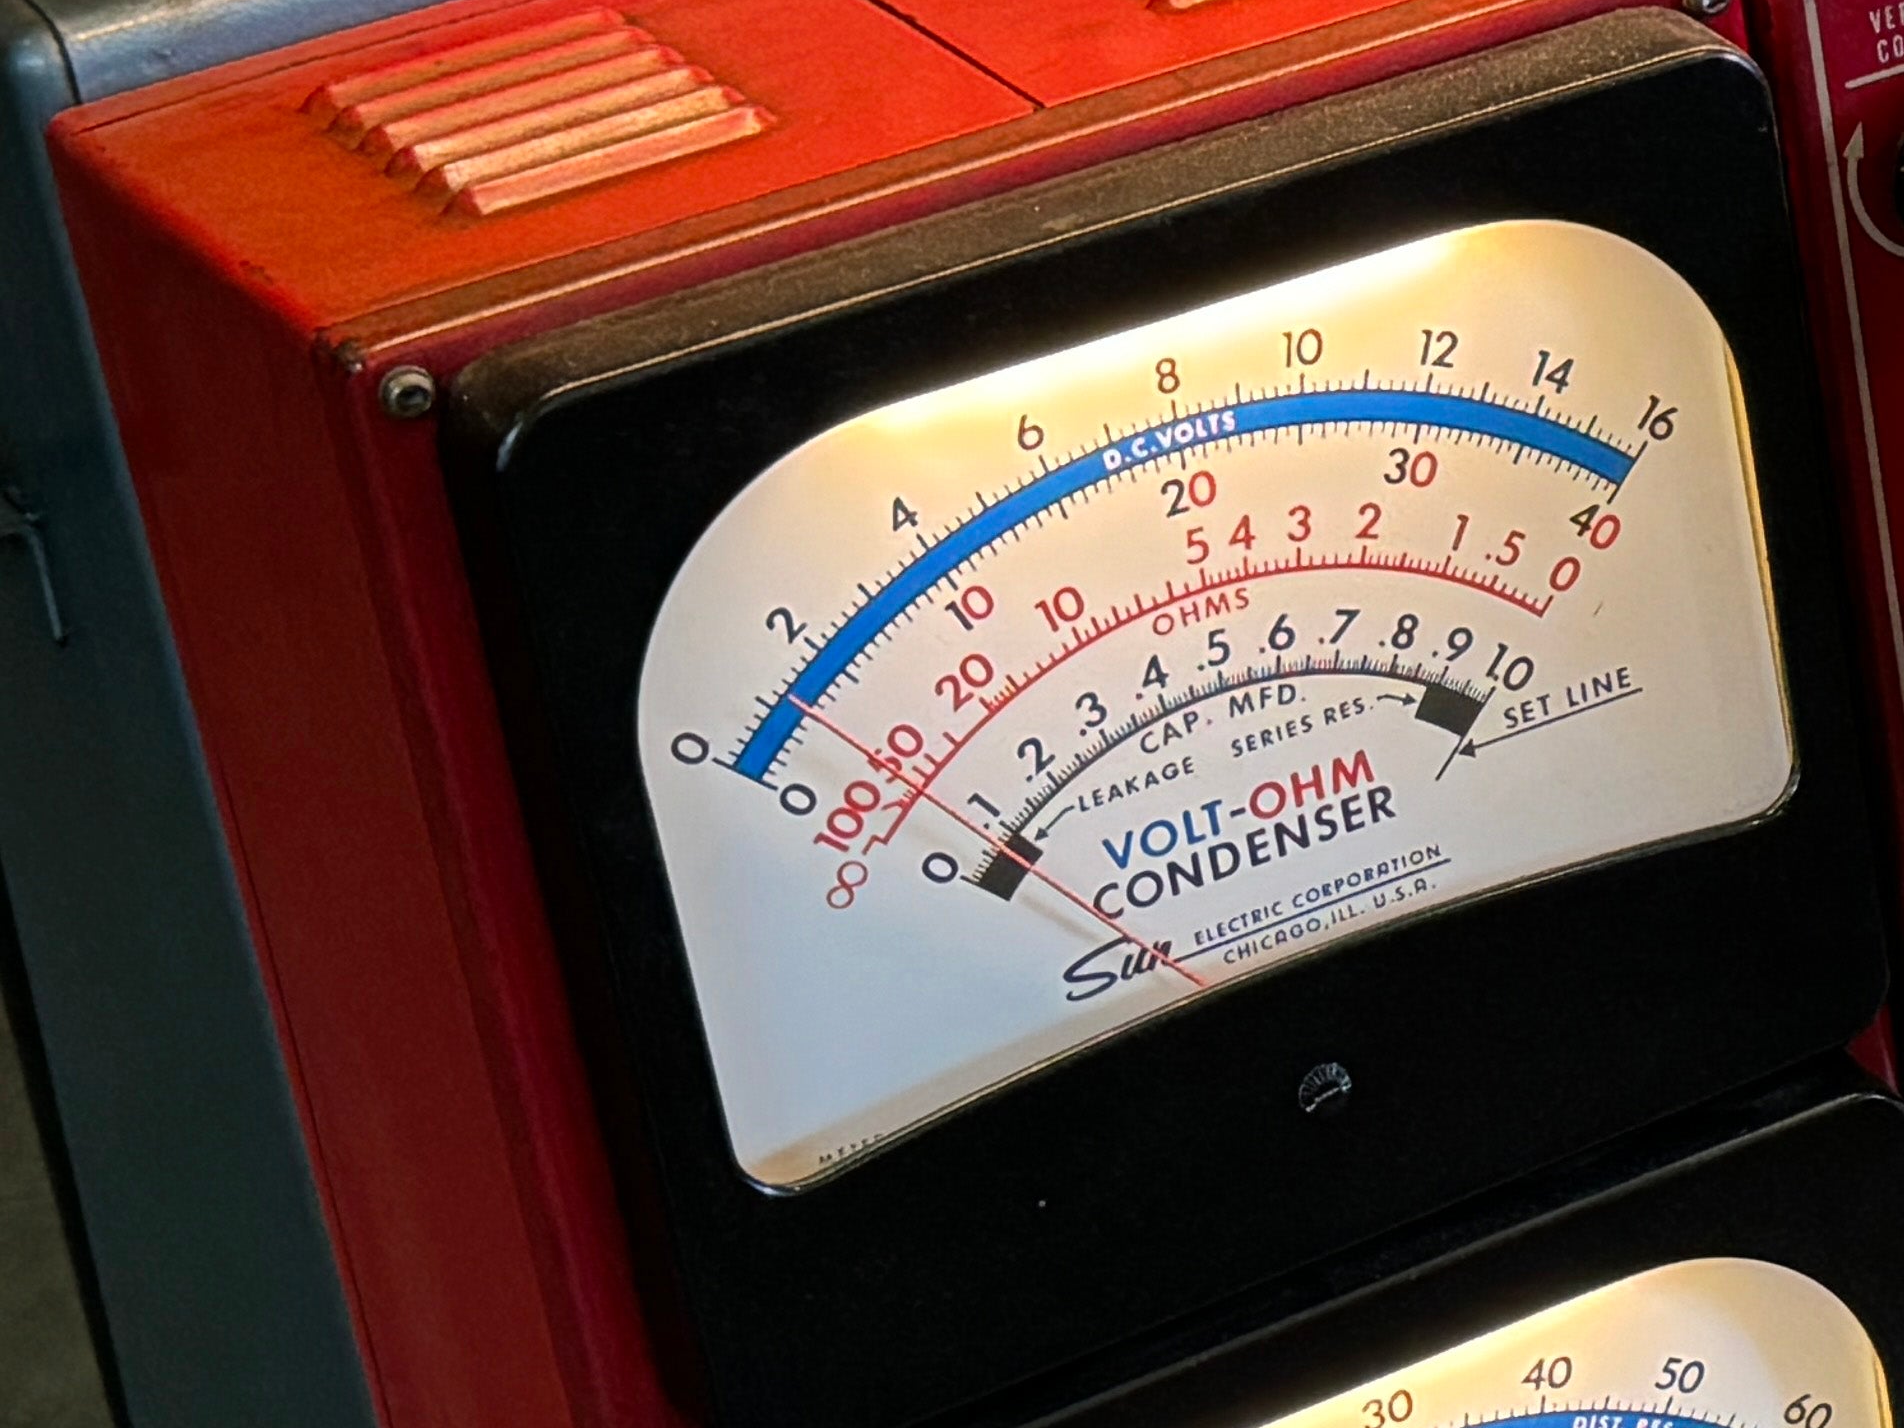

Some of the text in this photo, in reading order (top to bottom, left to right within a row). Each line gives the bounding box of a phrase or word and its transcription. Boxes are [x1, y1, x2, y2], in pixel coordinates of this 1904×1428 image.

[670, 328, 1679, 765] 0 2 4 6 8 10 12 14 16
[779, 447, 1621, 816] 0 10 20 30 40
[1152, 587, 1251, 637] OHMS
[1139, 683, 1307, 754] CAP. MFD.
[1230, 696, 1374, 758] SERIES RES.
[1503, 667, 1633, 730] SET LINE
[1077, 755, 1196, 813] LEAKAGE
[1102, 748, 1375, 870] VOLT-OHM
[1092, 784, 1396, 920] CONDENSER
[1194, 843, 1443, 945] ELECTRIC CORPORATION
[1373, 878, 1437, 909] U.S.A.
[1522, 1356, 1573, 1390] 40
[1654, 1357, 1706, 1394] 50
